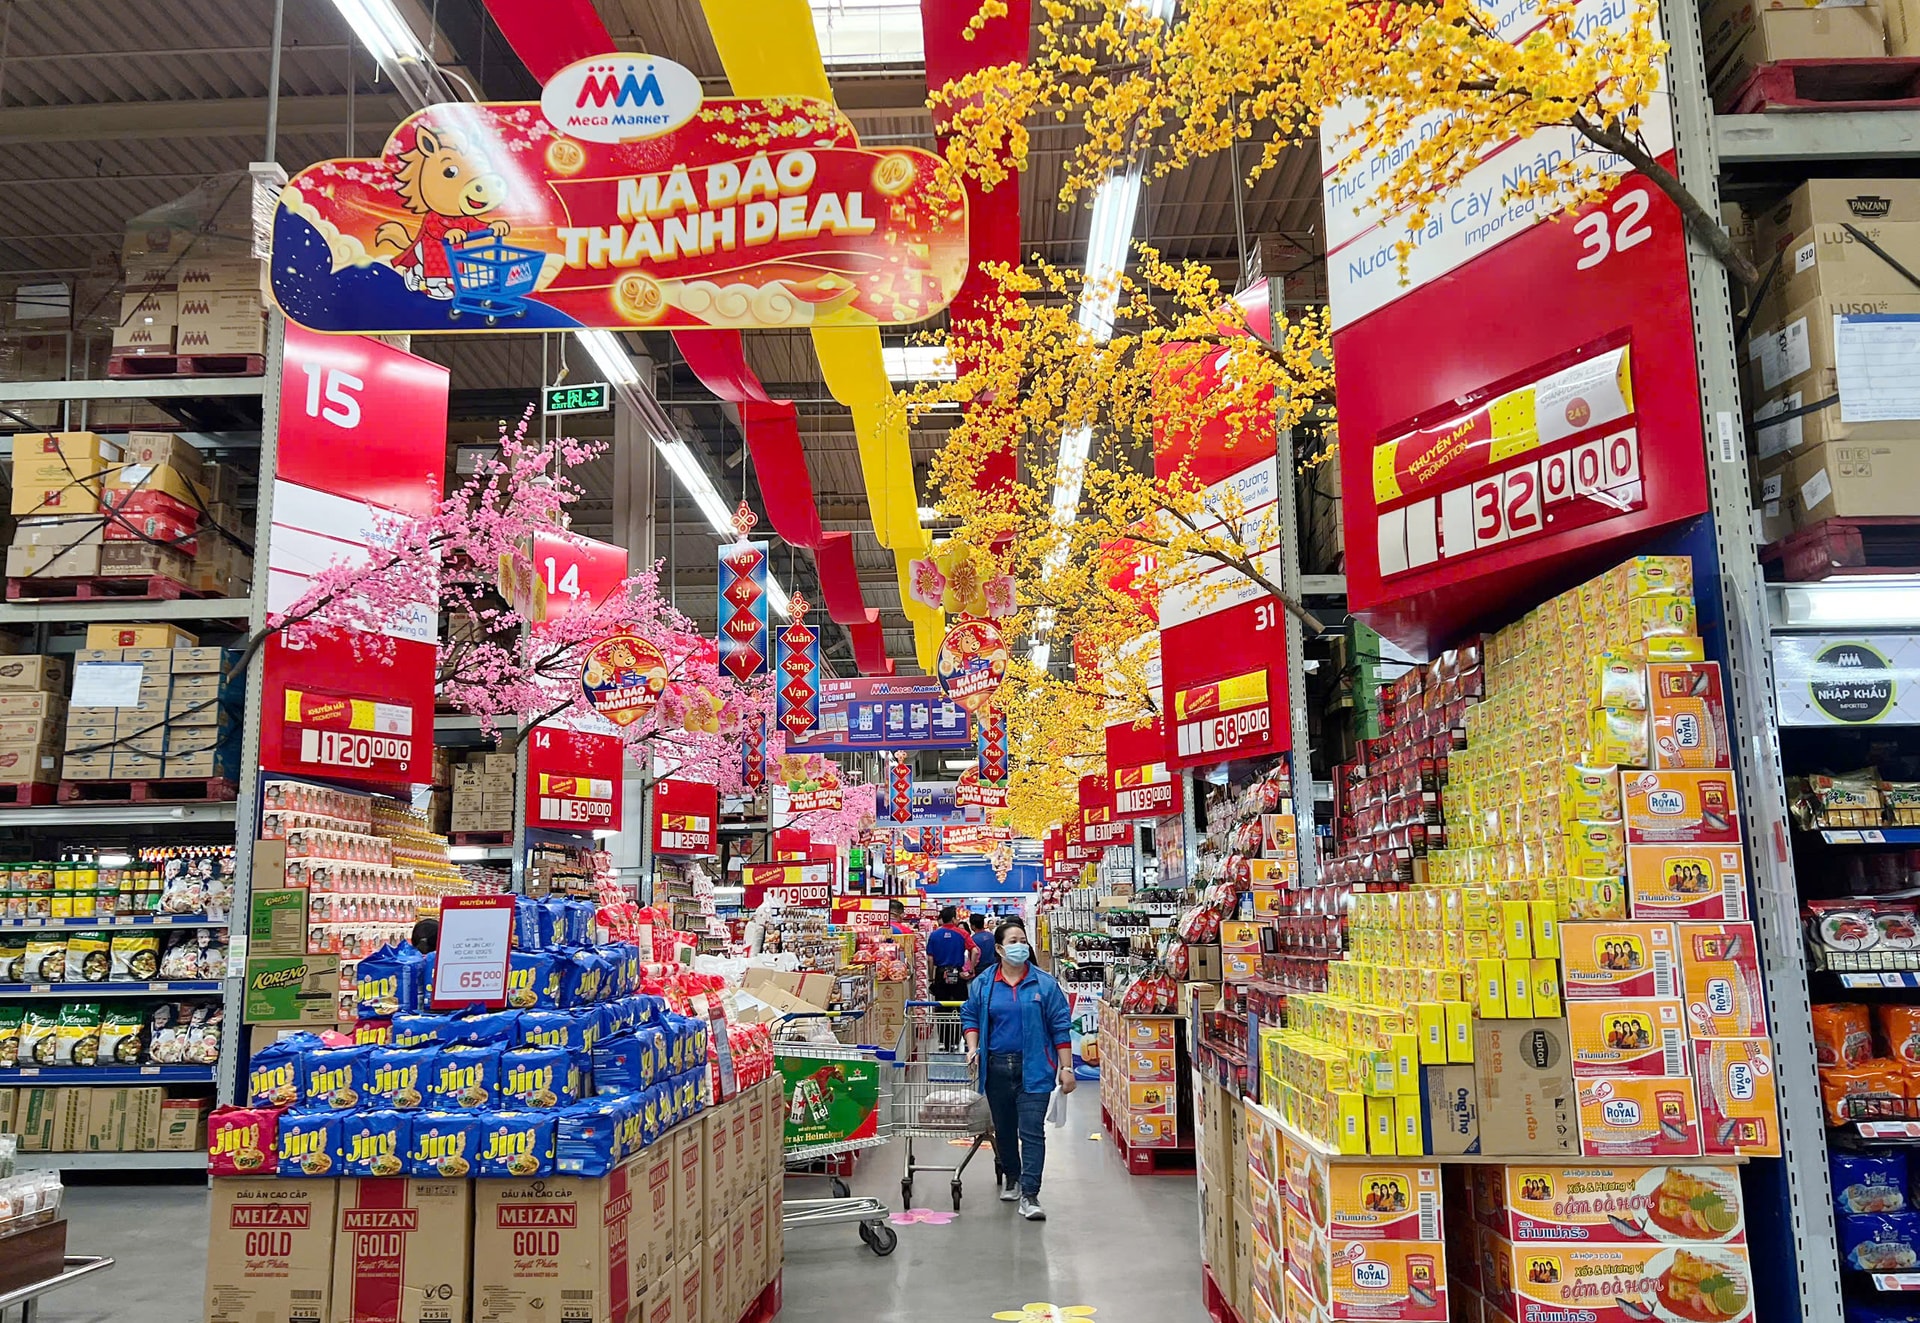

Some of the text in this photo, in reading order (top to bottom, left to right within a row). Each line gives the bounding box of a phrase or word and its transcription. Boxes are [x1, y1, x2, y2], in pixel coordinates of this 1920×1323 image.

[617, 151, 816, 221] MÃ ĐÁO
[1851, 201, 1888, 212] PANZANI
[557, 192, 875, 268] THÀNH DEAL
[1464, 196, 1535, 246] Imported
[1574, 189, 1652, 270] 32
[1349, 244, 1397, 284] Nước
[1451, 187, 1493, 225] Cây
[1801, 248, 1814, 262] S10
[302, 364, 364, 429] 15
[1418, 439, 1469, 484] PROMOTION
[544, 557, 580, 597] 14
[731, 553, 756, 667] Vạn Sự Như Ý
[1254, 602, 1275, 631] 31
[786, 633, 810, 725] Xuân Sang Vạn Phúc
[1818, 685, 1887, 701] NHẬP KHẨU
[536, 731, 551, 748] 14
[1682, 717, 1692, 745] ROYAL
[658, 782, 669, 795] 13
[1651, 798, 1680, 808] ROYAL
[251, 965, 308, 990] KORENO
[1715, 983, 1726, 1011] ROYAL
[1491, 1030, 1503, 1073] ice tea
[1534, 1034, 1545, 1064] Lipton
[251, 1066, 285, 1097] jin
[306, 1068, 344, 1098] jin
[369, 1067, 408, 1095] jin
[503, 1068, 543, 1096] jin
[1735, 1066, 1746, 1095] ROYAL
[1455, 1087, 1471, 1135] Ông Thọ
[1606, 1106, 1636, 1118] ROYAL
[209, 1126, 250, 1156] jin
[1527, 1116, 1538, 1140] đào
[279, 1130, 318, 1160] jin
[483, 1131, 526, 1160] jin
[535, 1190, 552, 1198] CAO
[234, 1209, 307, 1225] MEIZAN
[345, 1212, 415, 1227] MEIZAN
[501, 1208, 574, 1225] MEIZAN
[245, 1231, 292, 1257] GOLD
[358, 1234, 400, 1257] GOLD
[513, 1231, 560, 1257] GOLD
[1357, 1268, 1386, 1280] ROYAL
